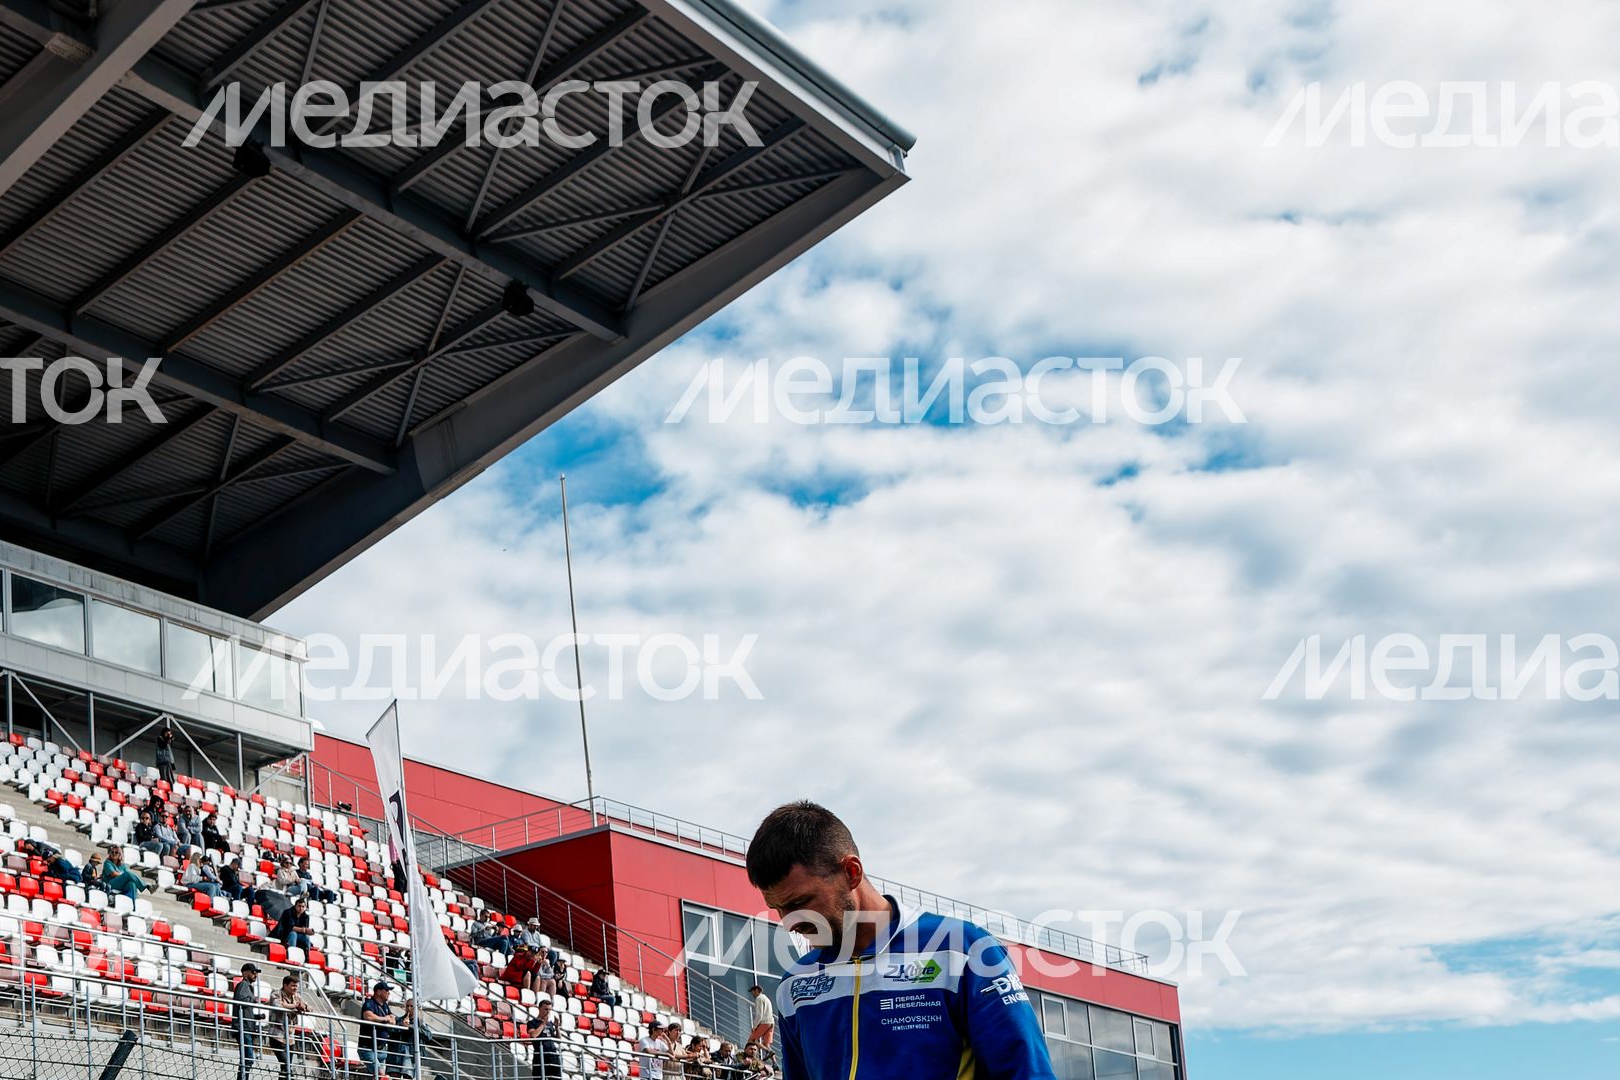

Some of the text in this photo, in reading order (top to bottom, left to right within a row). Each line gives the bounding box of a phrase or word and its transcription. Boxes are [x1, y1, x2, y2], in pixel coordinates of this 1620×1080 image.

[895, 994, 925, 1002] ПЕРВАЯ
[895, 1001, 941, 1009] МЕБЕЛЬНАЯ
[881, 1015, 942, 1025] CHAMOVSKIKH
